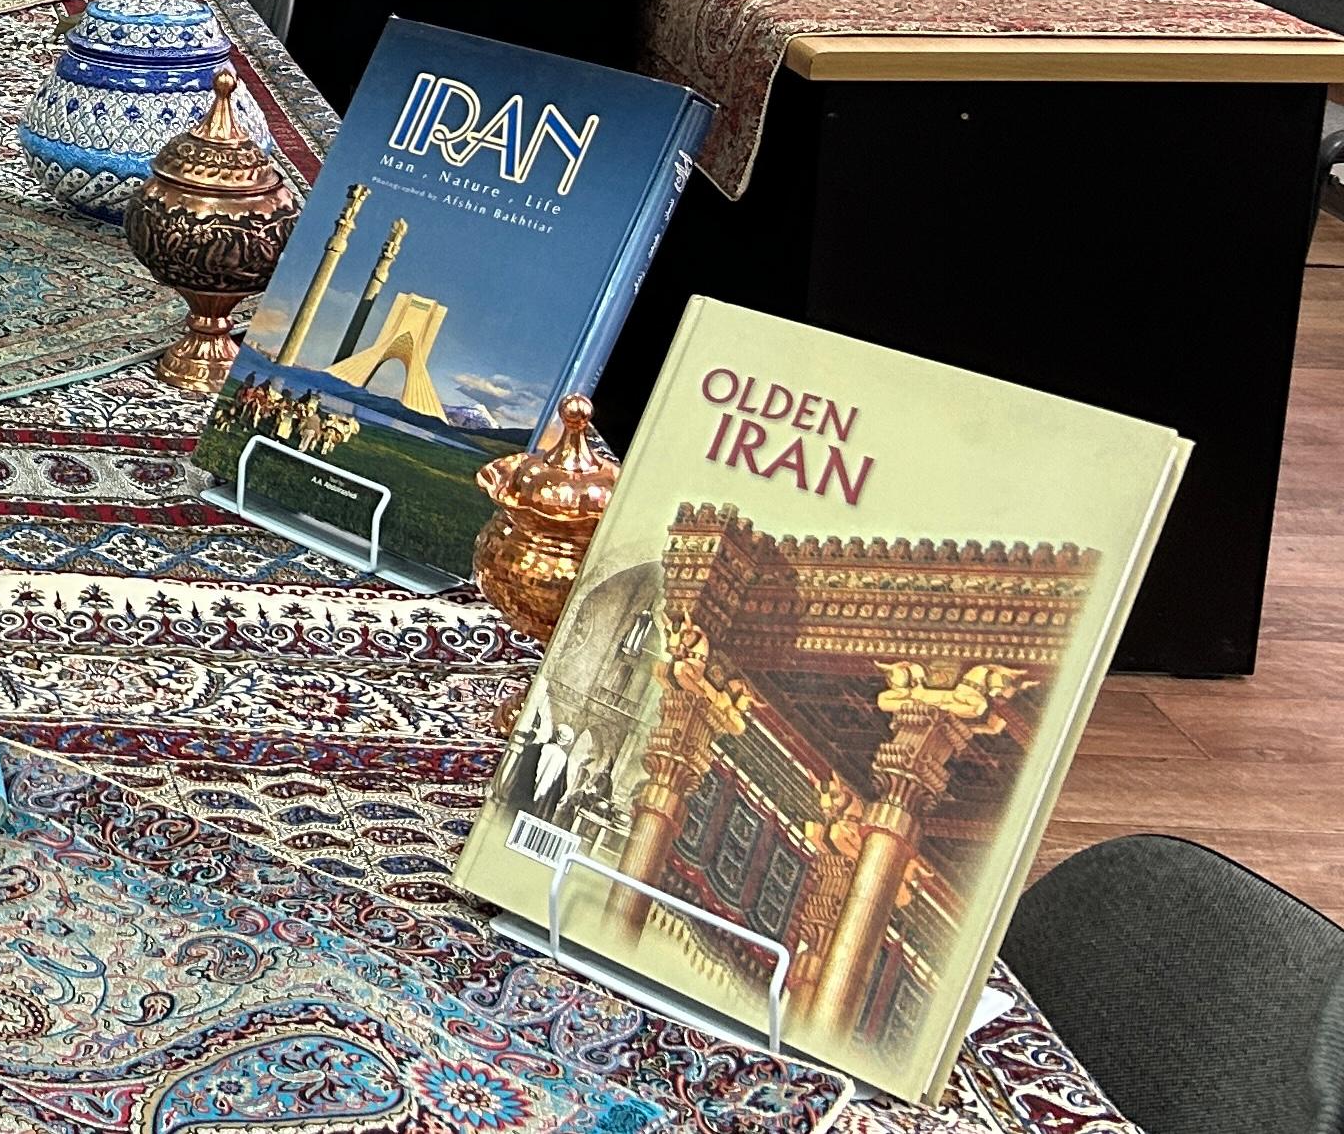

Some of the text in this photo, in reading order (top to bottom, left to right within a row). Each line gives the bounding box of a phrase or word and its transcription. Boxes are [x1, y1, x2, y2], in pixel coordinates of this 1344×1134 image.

[388, 72, 600, 197] IRAN
[379, 154, 415, 174] Man
[438, 170, 501, 199] Nature
[524, 194, 562, 216] Life
[442, 193, 488, 216] Afshin
[492, 208, 555, 235] Bakhtiar
[701, 367, 859, 442] OLDEN
[705, 412, 875, 507] IRAN
